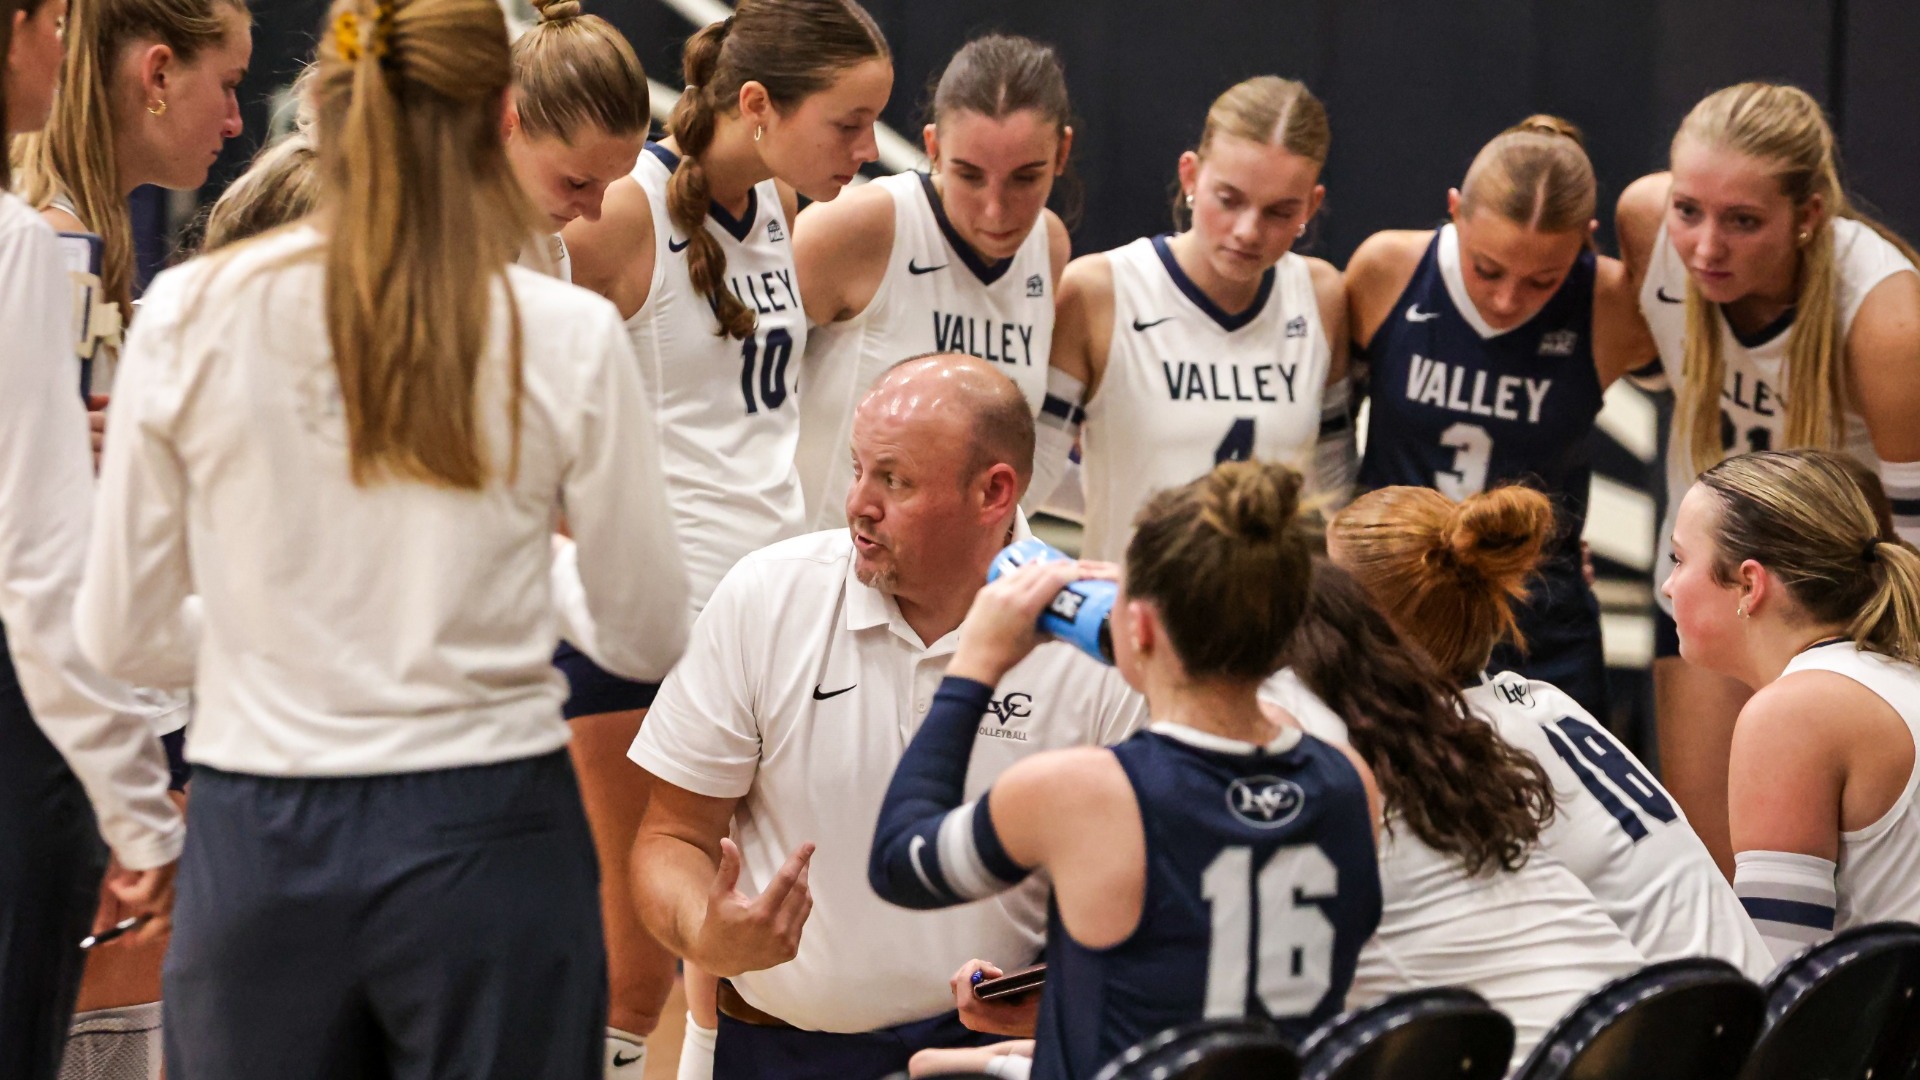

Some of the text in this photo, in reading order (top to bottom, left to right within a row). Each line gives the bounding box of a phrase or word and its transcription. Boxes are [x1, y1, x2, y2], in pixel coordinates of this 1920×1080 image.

[706, 269, 798, 319] LLEY
[933, 311, 1032, 366] VALLEY
[740, 327, 792, 415] 10
[1162, 360, 1297, 403] VALLEY
[1406, 353, 1552, 424] VALLEY
[1433, 421, 1494, 503] 3
[978, 726, 1027, 741] OLLEYBALL
[985, 692, 1032, 726] VC
[1540, 715, 1678, 843] 18
[1201, 843, 1338, 1020] 16
